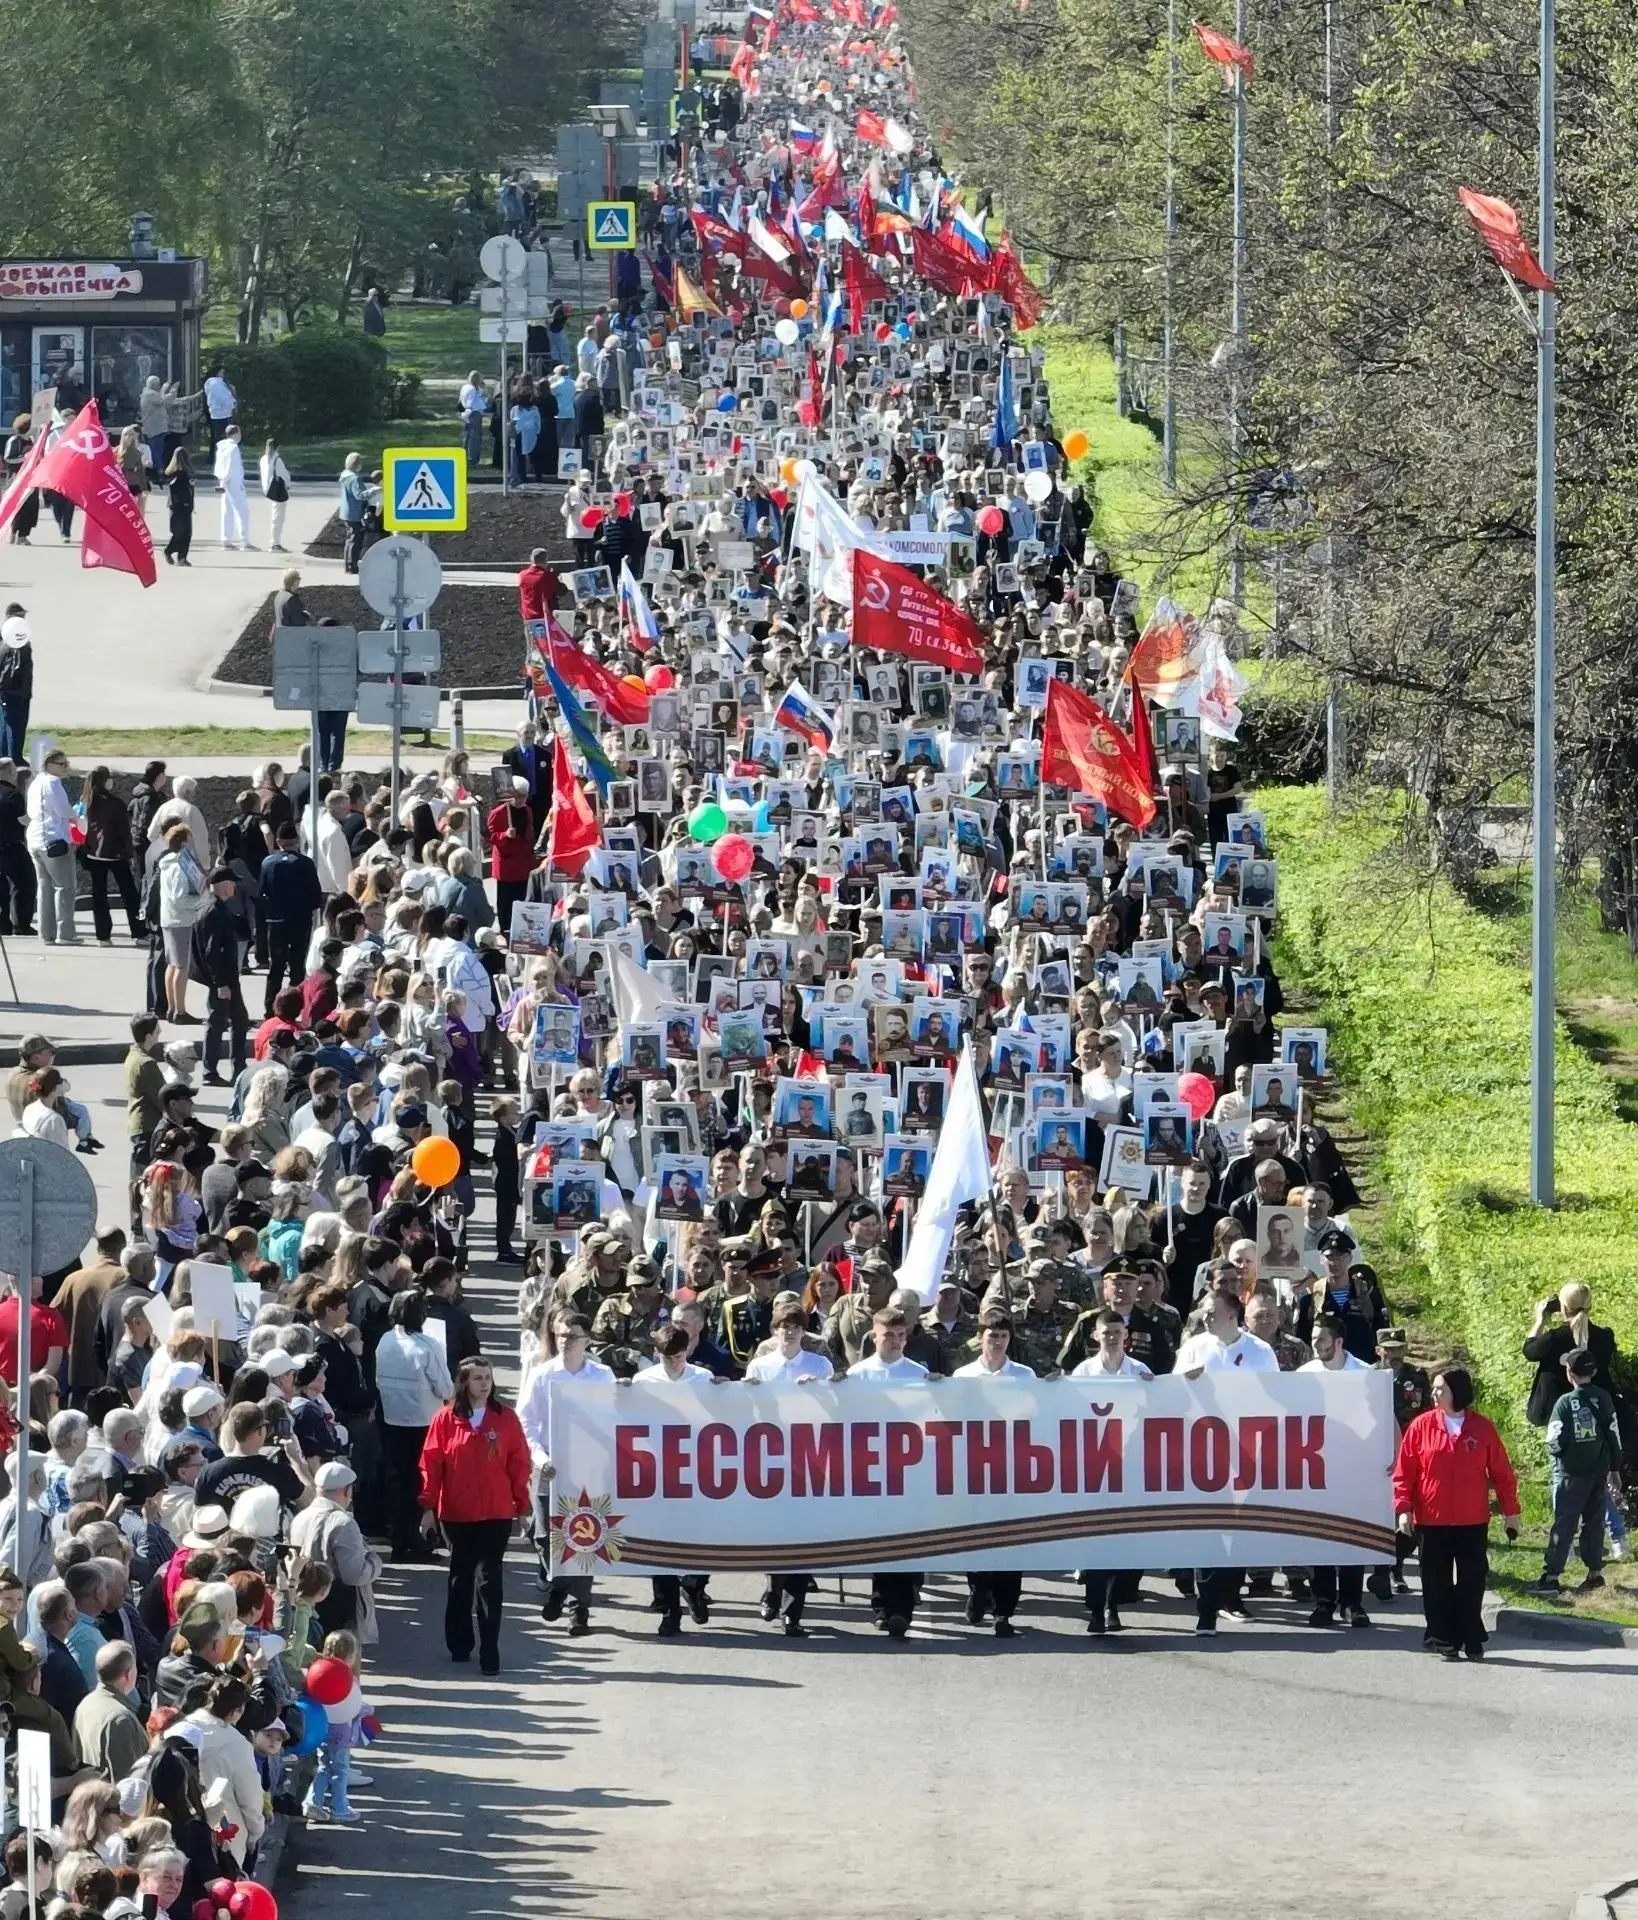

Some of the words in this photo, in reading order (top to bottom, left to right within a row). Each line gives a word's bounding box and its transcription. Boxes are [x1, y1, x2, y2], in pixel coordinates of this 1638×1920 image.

[25, 276, 131, 295] ВЫПЕЧКА
[615, 1402, 1123, 1500] БЕССМЕРТНЫЙ
[1144, 1414, 1326, 1493] ПОЛК
